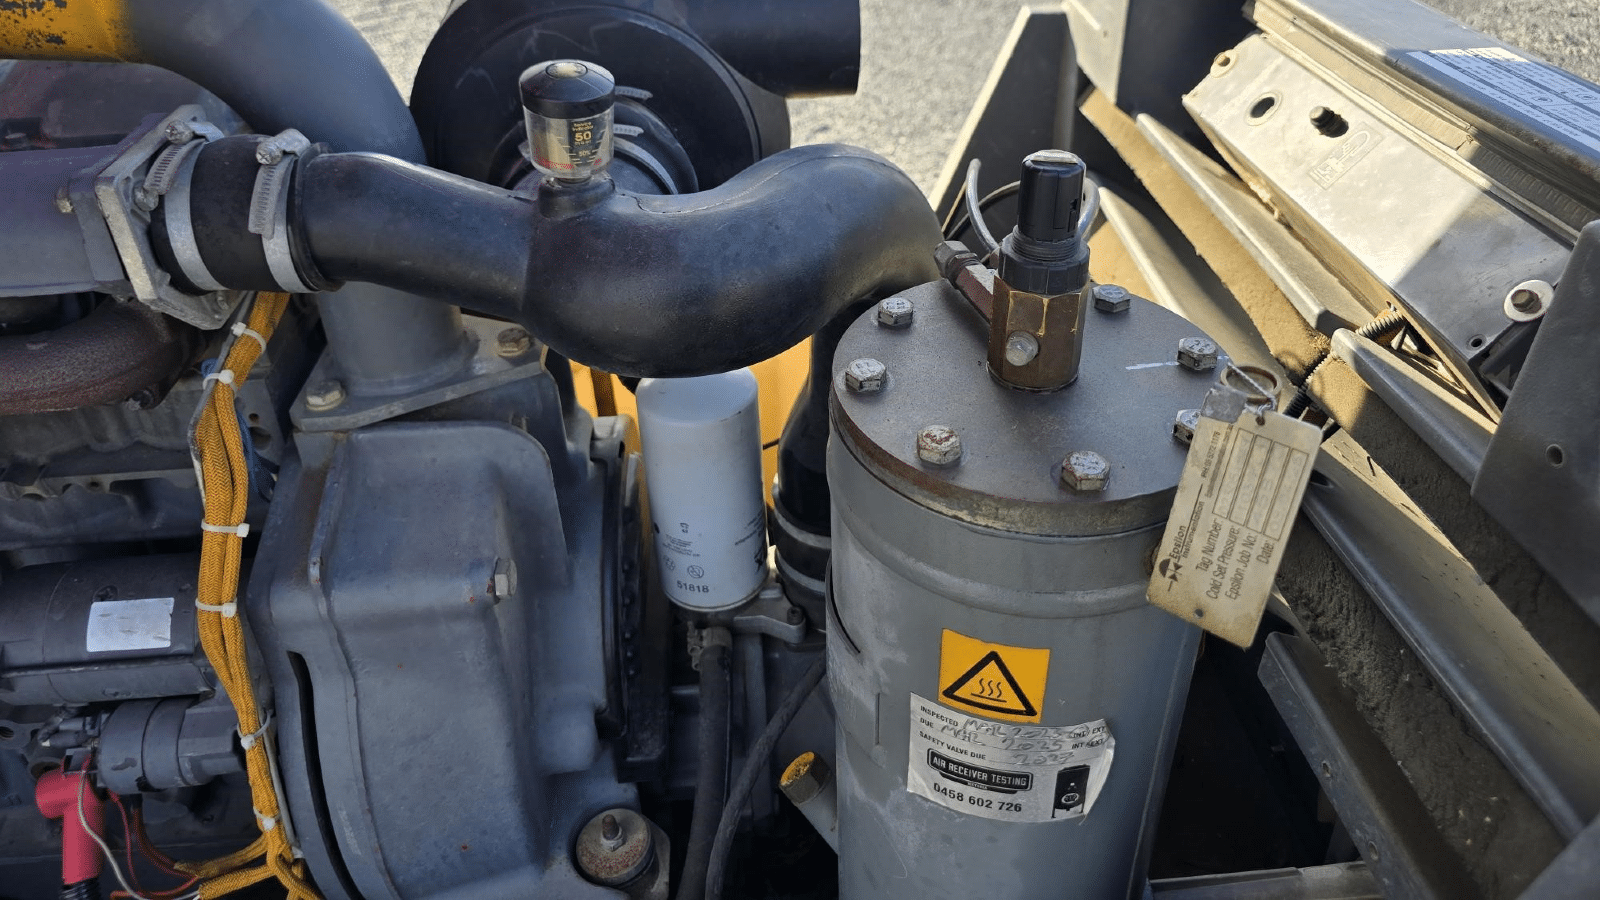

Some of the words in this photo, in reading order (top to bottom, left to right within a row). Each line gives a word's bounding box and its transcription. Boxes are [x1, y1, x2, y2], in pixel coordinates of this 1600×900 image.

[575, 131, 591, 141] 50
[1169, 525, 1186, 560] Epsilon
[1182, 501, 1205, 558] Instrumentation
[1201, 517, 1223, 556] Number:
[1217, 524, 1240, 564] Pressure:
[1195, 555, 1213, 573] Tag
[1235, 549, 1251, 567] Job
[1257, 540, 1275, 564] Date:
[1212, 563, 1227, 579] Set
[1224, 566, 1247, 600] Epsilon
[676, 580, 709, 593] 51818
[1206, 578, 1222, 600] Cold
[920, 705, 959, 727] INSPECTED
[1092, 726, 1105, 734] EXT
[920, 717, 934, 728] DUE
[919, 730, 945, 747] SAFETY
[946, 743, 969, 756] VALVE
[970, 751, 986, 760] DUE
[932, 756, 946, 769] AIR
[948, 762, 988, 780] RECEIVER
[990, 773, 1027, 786] TESTING
[933, 782, 964, 802] 0458
[968, 796, 993, 809] 602
[997, 801, 1022, 812] 726
